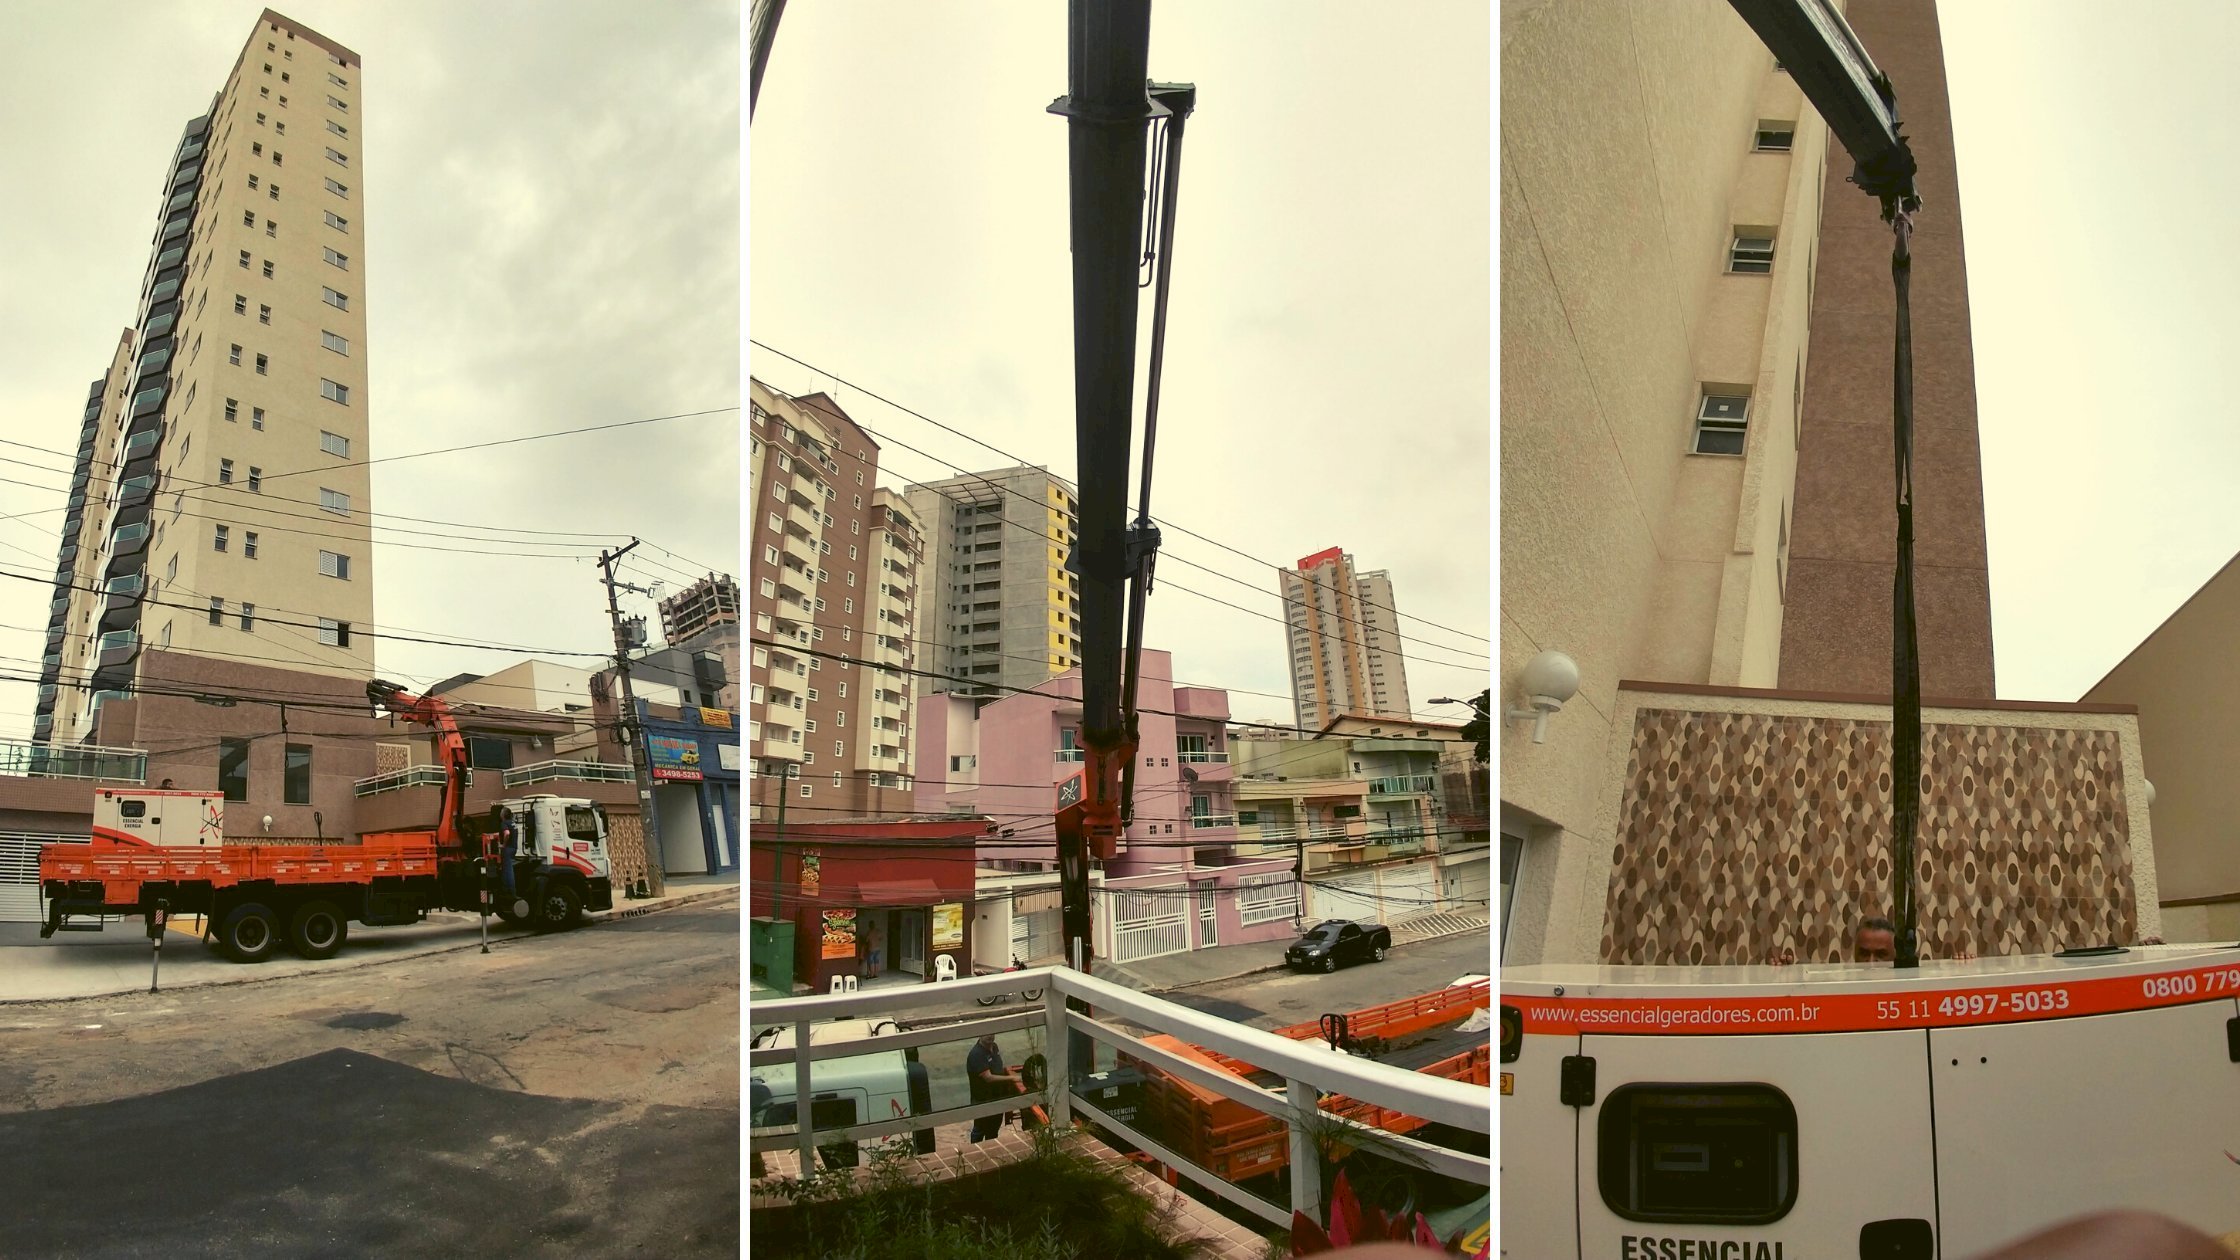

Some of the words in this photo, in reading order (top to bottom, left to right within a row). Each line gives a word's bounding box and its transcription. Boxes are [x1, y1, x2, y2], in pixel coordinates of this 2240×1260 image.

[2143, 974, 2197, 998] 0800
[2202, 969, 2240, 993] 779
[1531, 1002, 1820, 1028] www.essencialgeradores.com.br
[1877, 1001, 1900, 1019] 55
[1909, 999, 1930, 1018] 11
[1938, 989, 2070, 1017] 4997-5033
